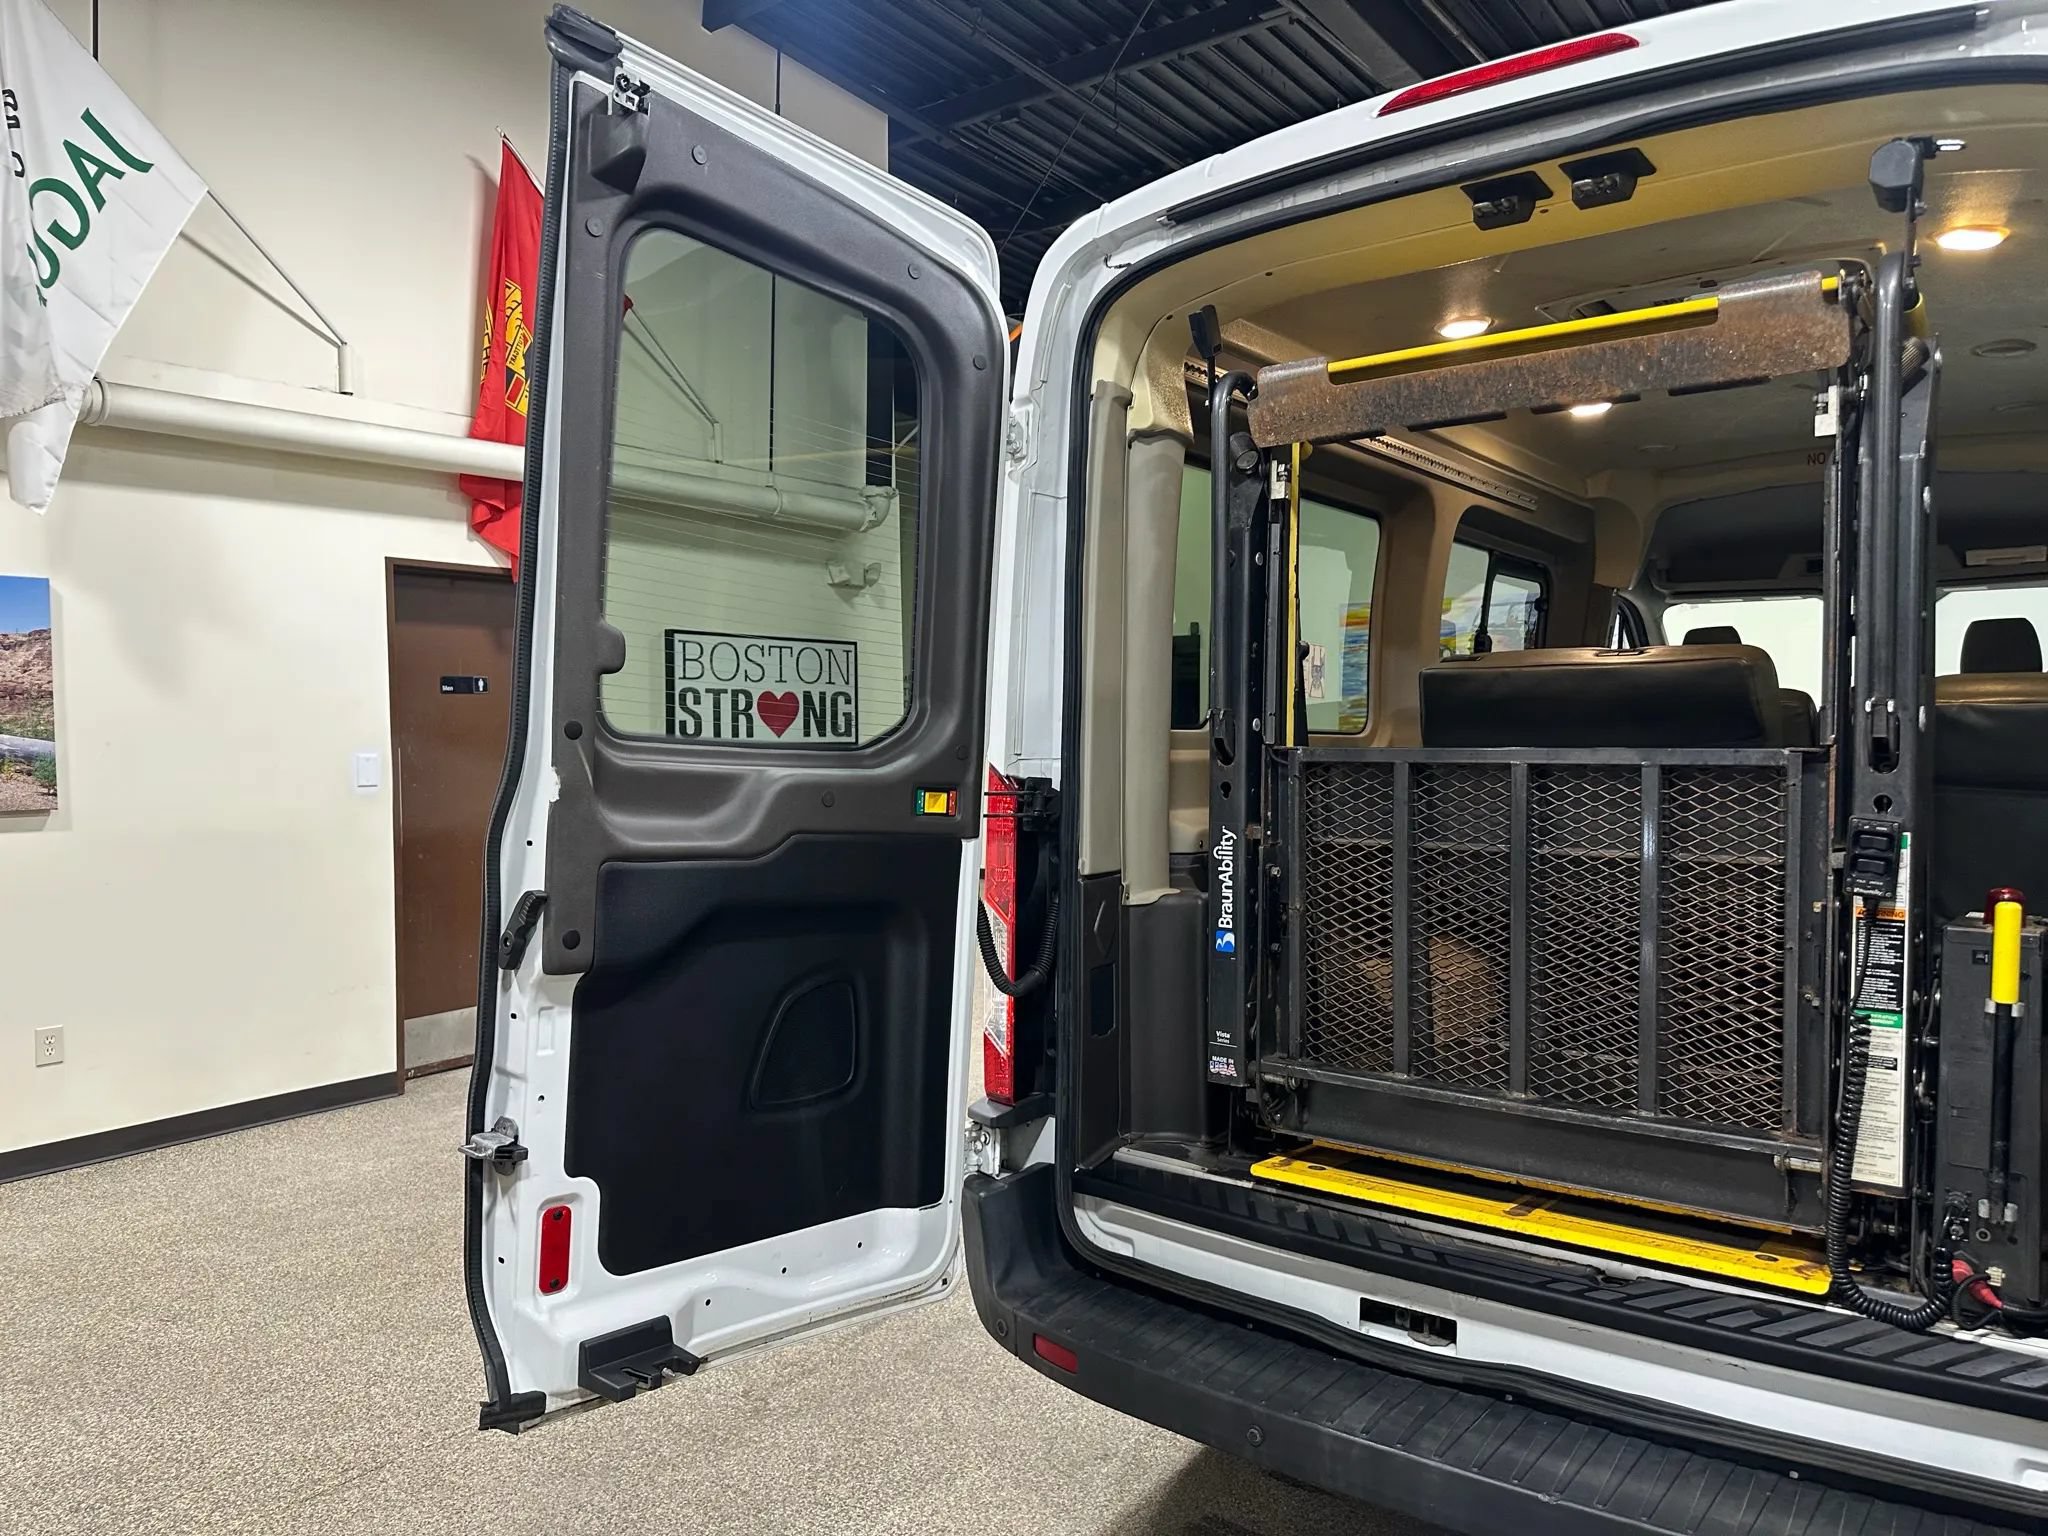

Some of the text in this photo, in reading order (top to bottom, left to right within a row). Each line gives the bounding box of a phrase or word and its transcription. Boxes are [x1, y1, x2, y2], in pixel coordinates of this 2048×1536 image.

[1808, 452, 1825, 464] NO
[678, 640, 852, 685] BOSTON
[678, 687, 852, 738] STRNG
[1213, 825, 1238, 928] BraunAbility
[1210, 1061, 1237, 1076] USA
